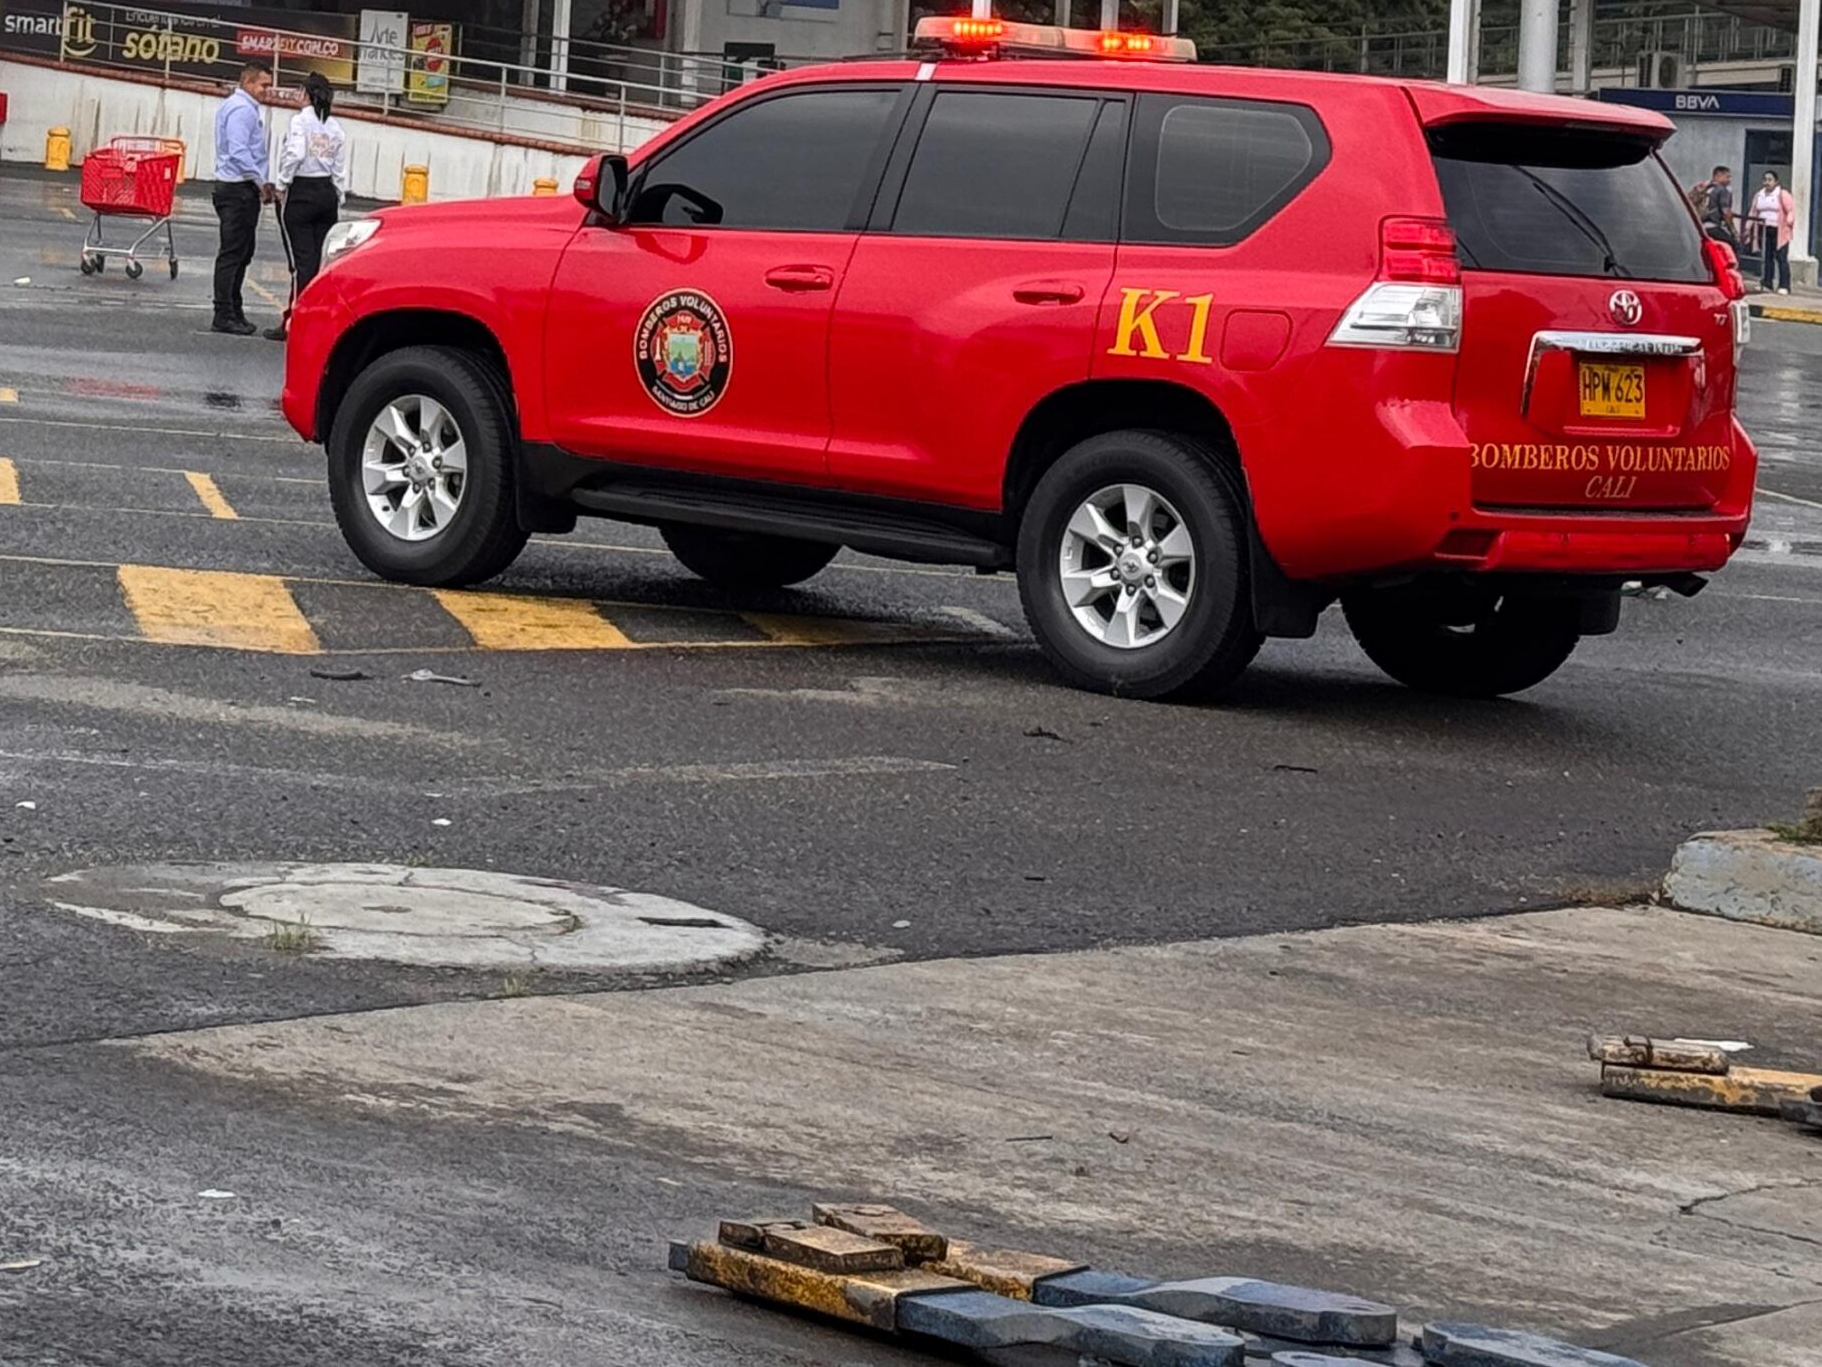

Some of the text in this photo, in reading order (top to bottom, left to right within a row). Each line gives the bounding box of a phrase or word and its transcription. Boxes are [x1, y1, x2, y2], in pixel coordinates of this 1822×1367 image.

[1675, 94, 1720, 110] BBVA
[638, 294, 728, 363] BOMBEROS VOLUNTARIOS
[1106, 286, 1215, 365] K1
[1614, 373, 1644, 403] 623
[1469, 442, 1731, 472] BOMBEROS VOLUNTARIOS
[1584, 475, 1637, 499] CALI
